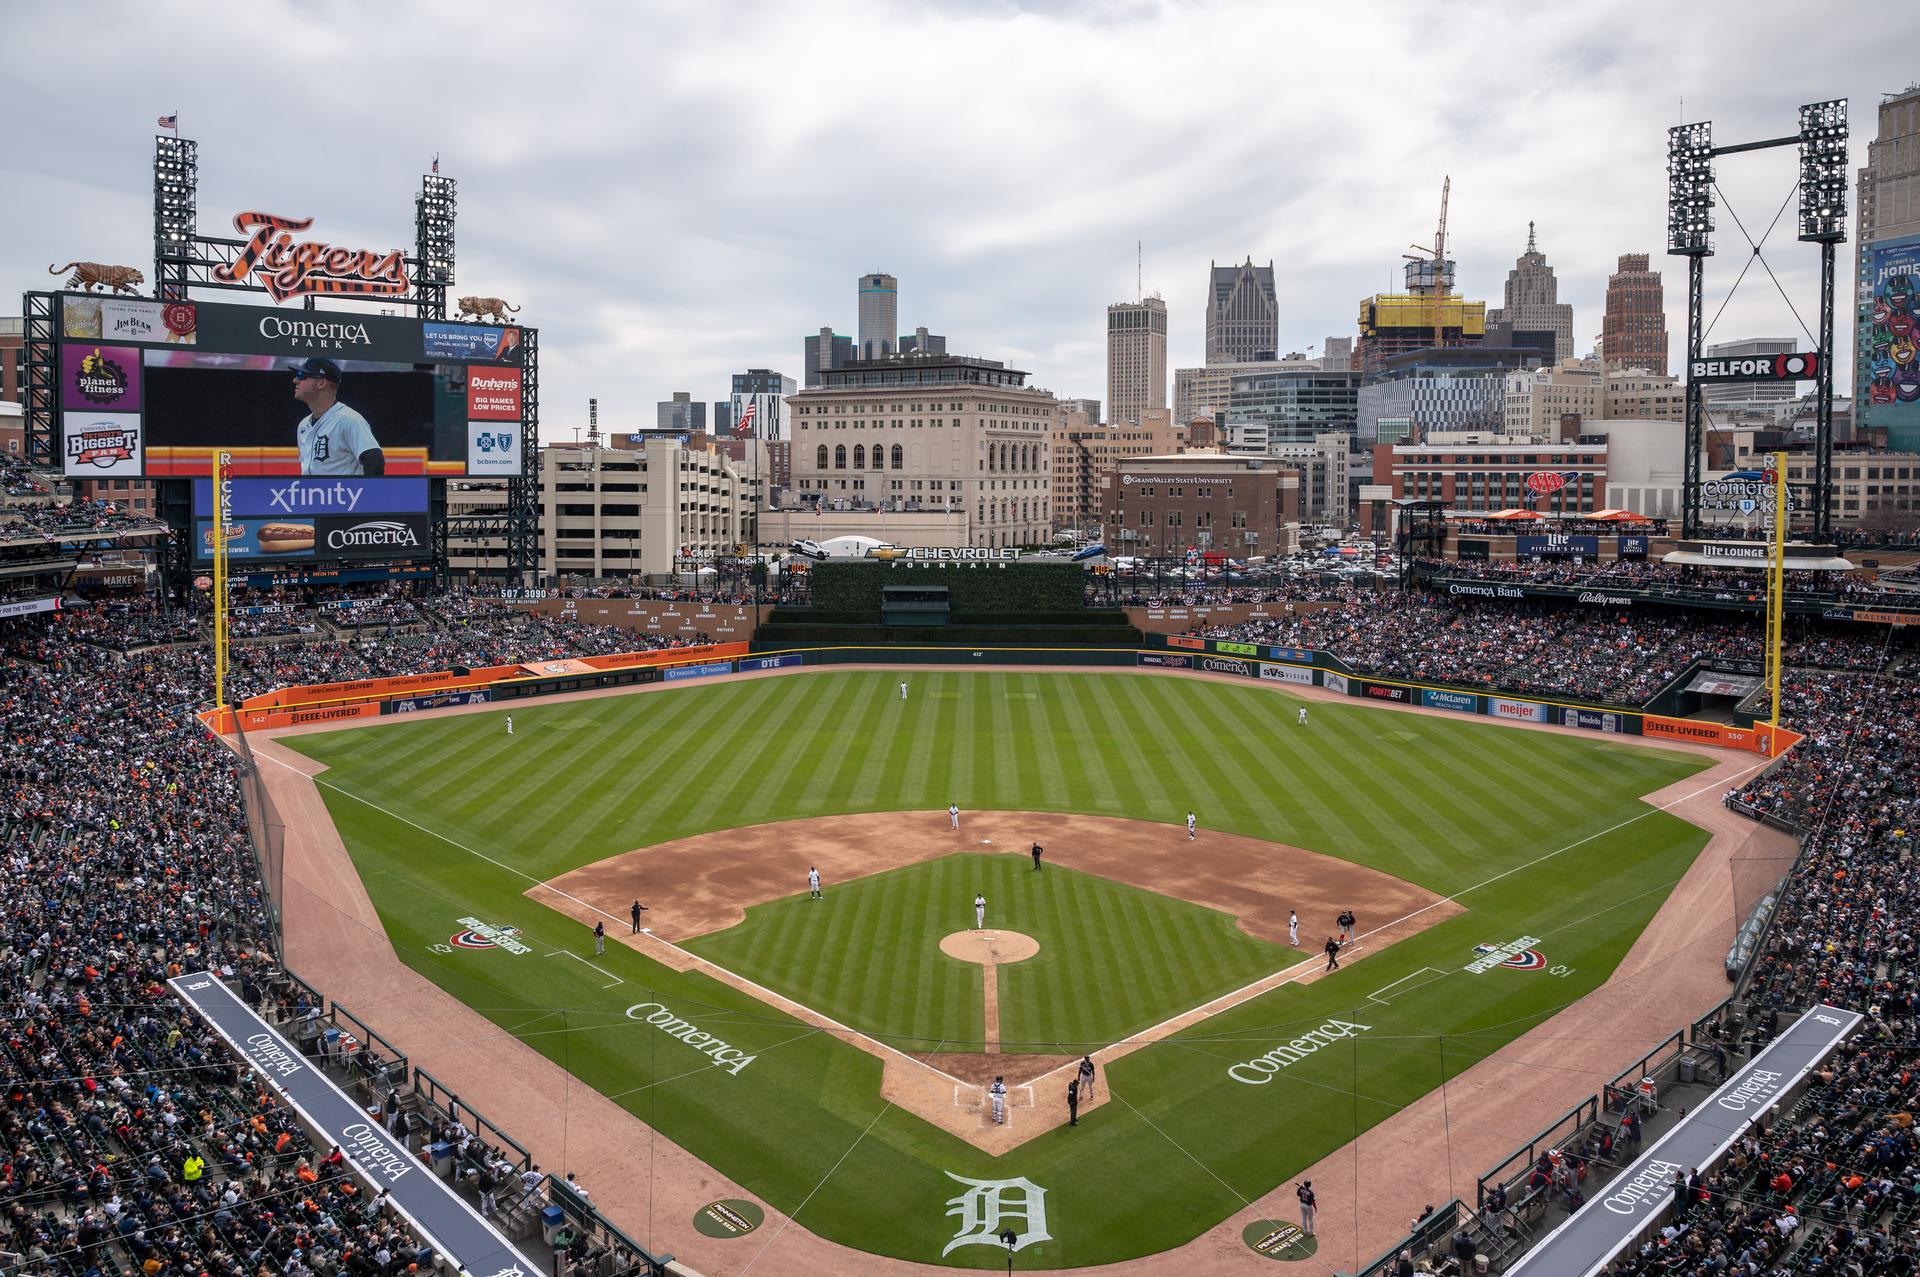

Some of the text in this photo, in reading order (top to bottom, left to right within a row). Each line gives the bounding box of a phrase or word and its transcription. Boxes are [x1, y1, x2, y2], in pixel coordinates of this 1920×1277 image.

[211, 211, 411, 306] Tigers
[114, 317, 152, 332] JIM BEAM
[292, 338, 342, 349] PARK
[448, 334, 468, 342] BRING
[1692, 359, 1770, 377] BELFOR
[80, 376, 116, 387] planet
[472, 377, 518, 389] Dunham's
[84, 385, 124, 394] fitness
[70, 432, 136, 454] BIGGEST
[91, 448, 118, 456] FAN
[1194, 476, 1232, 484] UNIVERSITY
[1530, 473, 1561, 491] AAA
[220, 452, 233, 535] ROCKET
[270, 480, 364, 513] xfinity
[1762, 455, 1778, 543] ROCKET
[1547, 534, 1570, 546] Lite
[676, 550, 716, 558] ROCKET
[912, 548, 1022, 560] CHEVROLET
[1704, 545, 1724, 558] Lite
[1724, 549, 1764, 558] LOUNGE
[104, 575, 138, 586] MARKET
[501, 589, 546, 598] 507 3090
[1497, 588, 1524, 598] Bank
[1579, 592, 1632, 606] Bally SPORTS
[761, 658, 780, 668] DTE
[1286, 672, 1310, 680] VISION
[1369, 686, 1404, 699] POINTSBET
[1440, 694, 1471, 704] McLaren
[1500, 703, 1534, 718] meijer
[1580, 714, 1600, 726] Modelo
[250, 1048, 276, 1071] PARK
[1751, 1080, 1779, 1104] PARK
[348, 1141, 378, 1170] PARK
[706, 1210, 737, 1232] GRASS SEED
[714, 1204, 750, 1230] PENNINGTON
[1256, 1226, 1296, 1250] PENNINGTON
[1270, 1233, 1304, 1256] GRASS SEED
